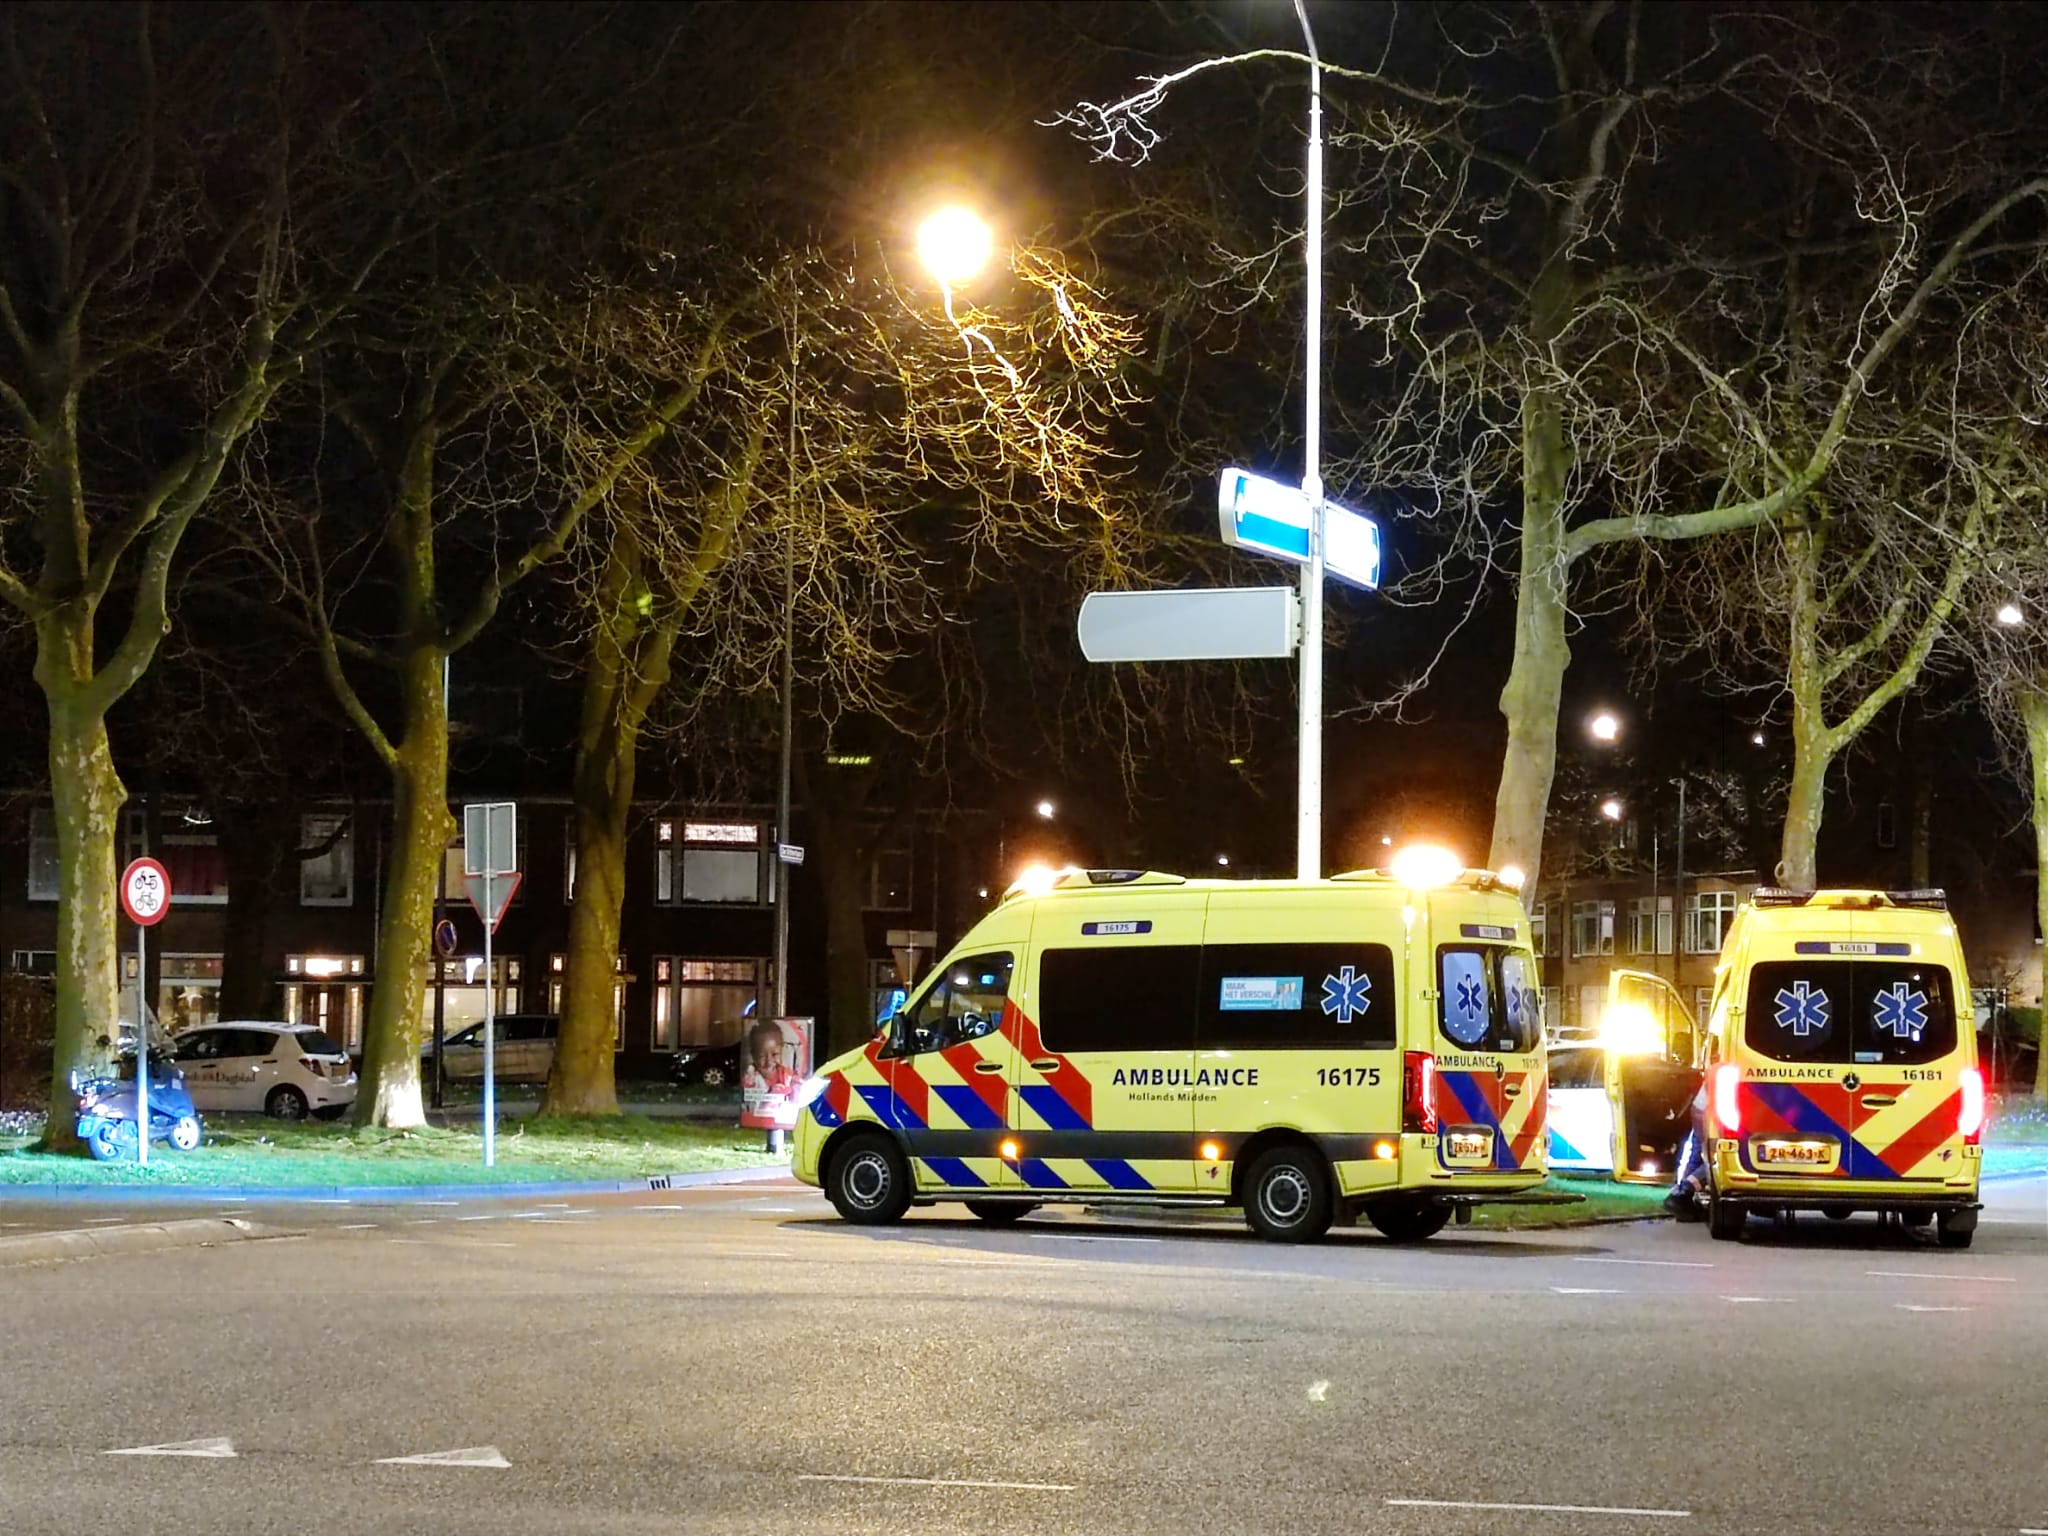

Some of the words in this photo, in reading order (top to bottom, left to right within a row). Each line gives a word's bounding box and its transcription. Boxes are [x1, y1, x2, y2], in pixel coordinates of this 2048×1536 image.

[1104, 924, 1130, 933] 16175
[1436, 1055, 1496, 1068] AMBULANCE
[1112, 1068, 1259, 1086] AMBULANCE
[1316, 1068, 1381, 1087] 16175
[1745, 1067, 1834, 1079] AMBULANCE
[1902, 1069, 1943, 1081] 16181
[1128, 1092, 1175, 1102] Hollands
[1177, 1092, 1218, 1102] Midden
